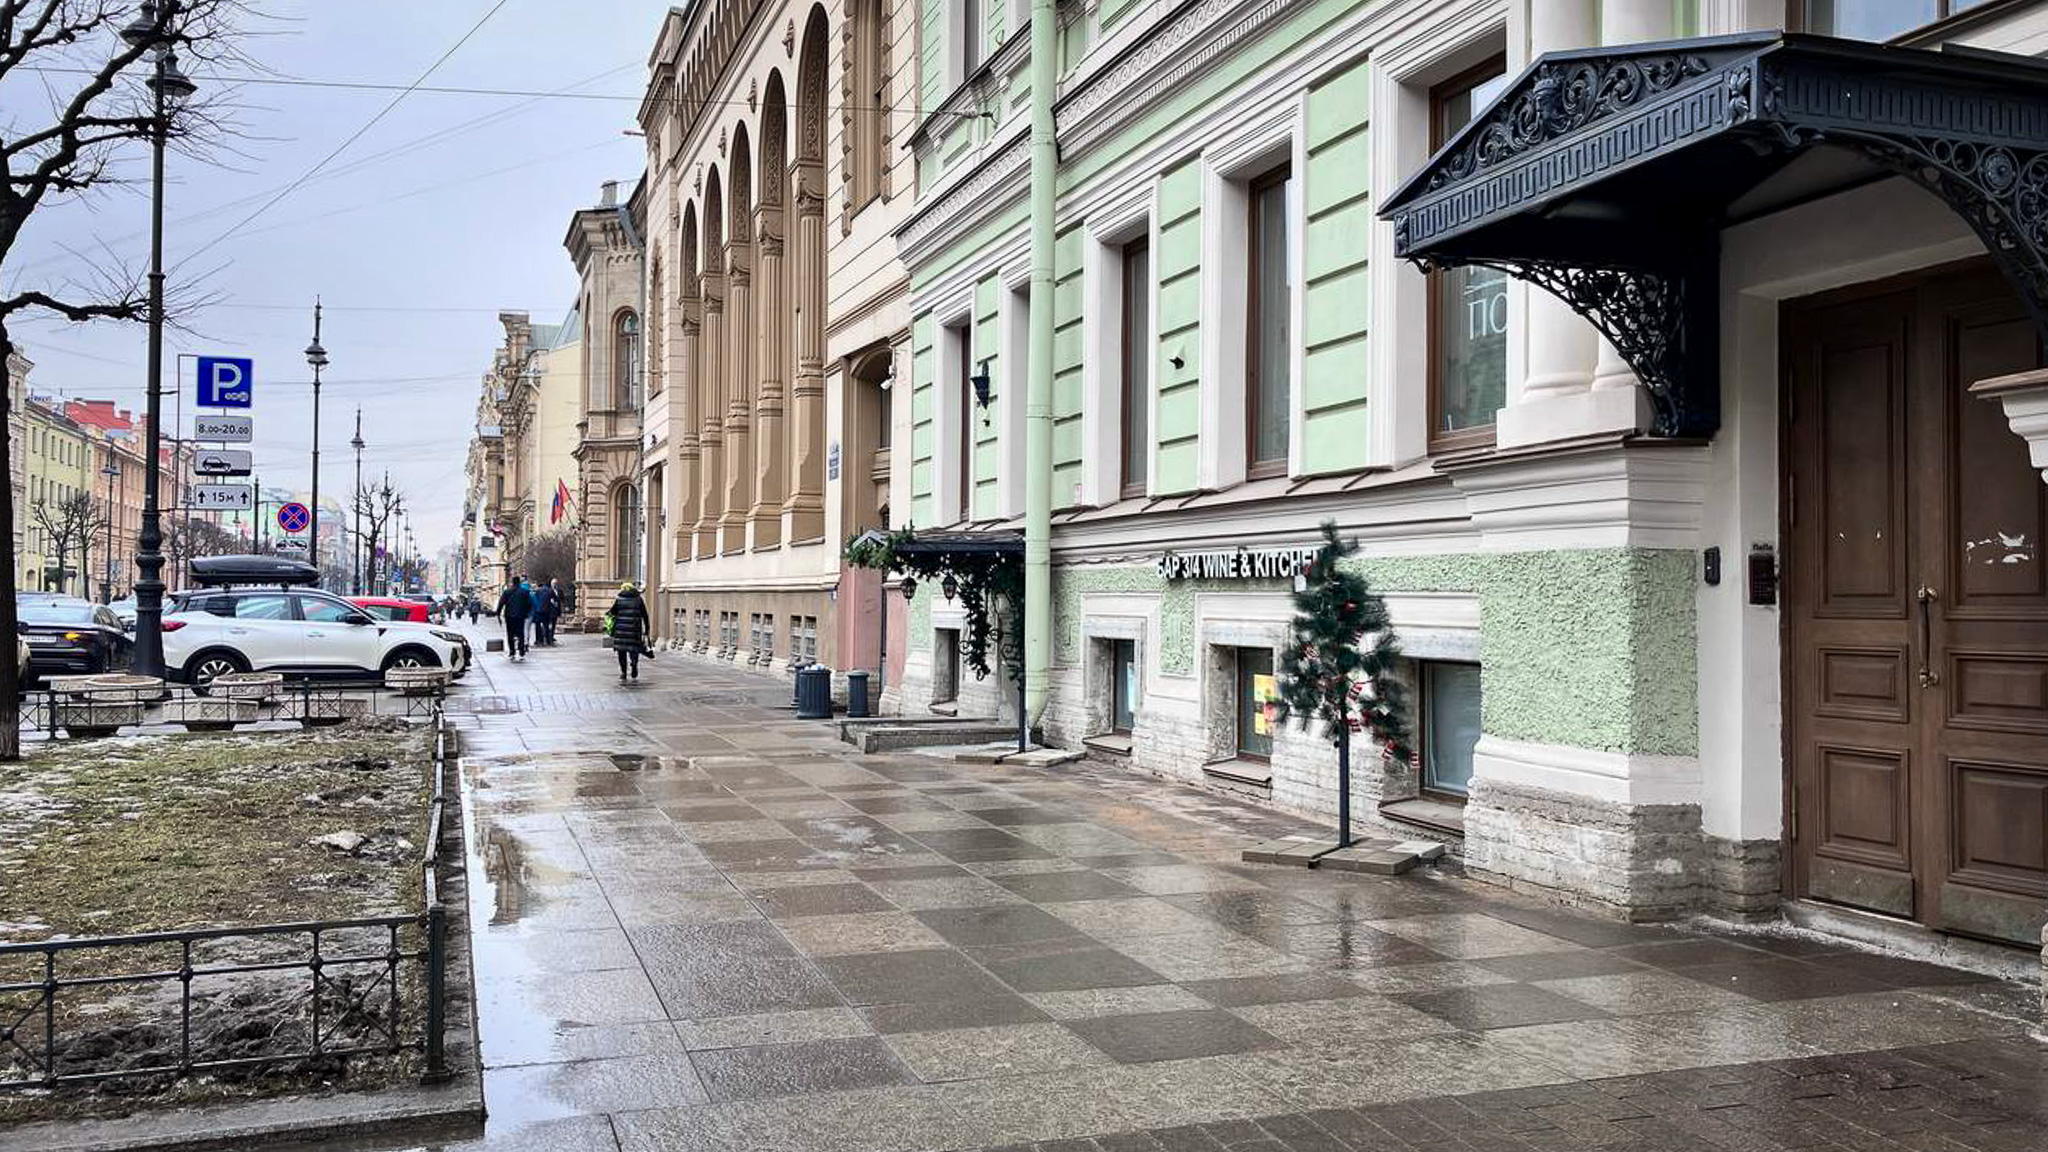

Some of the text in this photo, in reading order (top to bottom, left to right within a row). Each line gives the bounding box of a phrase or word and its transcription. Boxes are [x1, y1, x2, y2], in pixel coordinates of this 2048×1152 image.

[198, 424, 250, 435] 8.00-20.00
[1156, 548, 1318, 579] БАР 3/4 WINE & KITCHE
